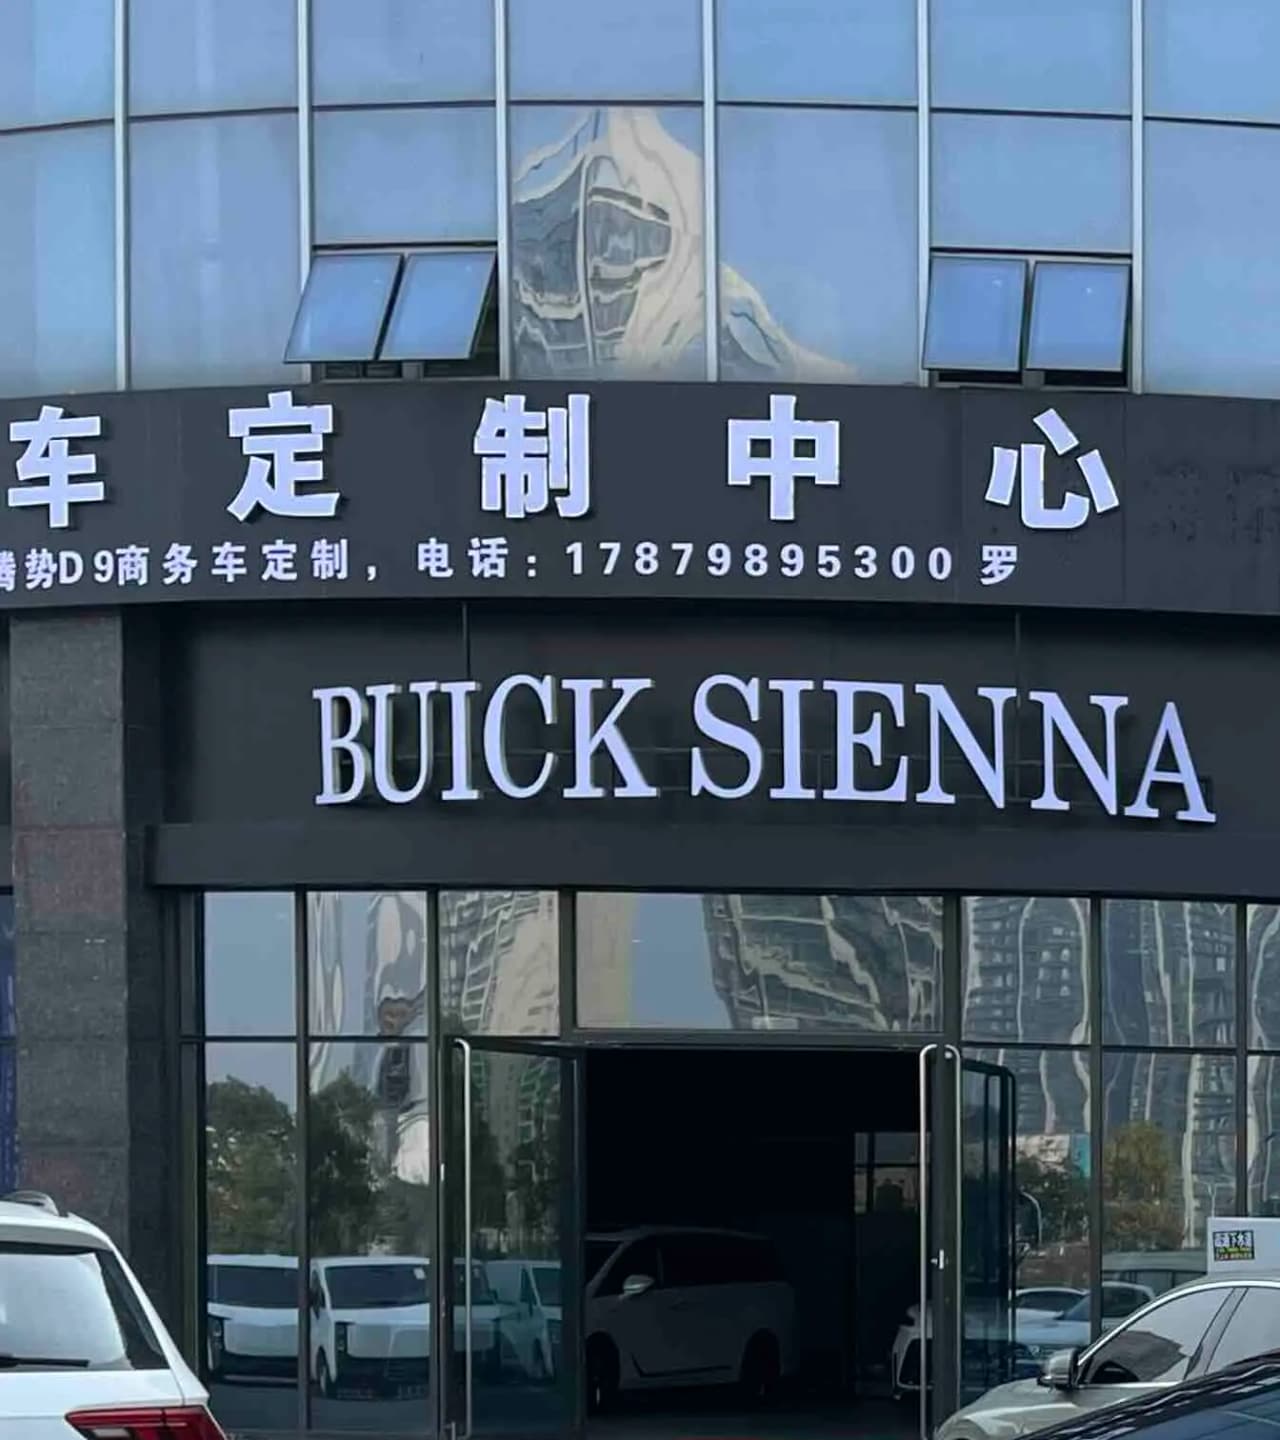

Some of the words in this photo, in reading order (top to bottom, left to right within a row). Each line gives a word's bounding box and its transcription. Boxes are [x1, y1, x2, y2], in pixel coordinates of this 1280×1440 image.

[8, 390, 1119, 529] 车定制中心
[980, 545, 1018, 585] 罗
[312, 674, 660, 804] BUICK
[691, 673, 1217, 823] SIENNA
